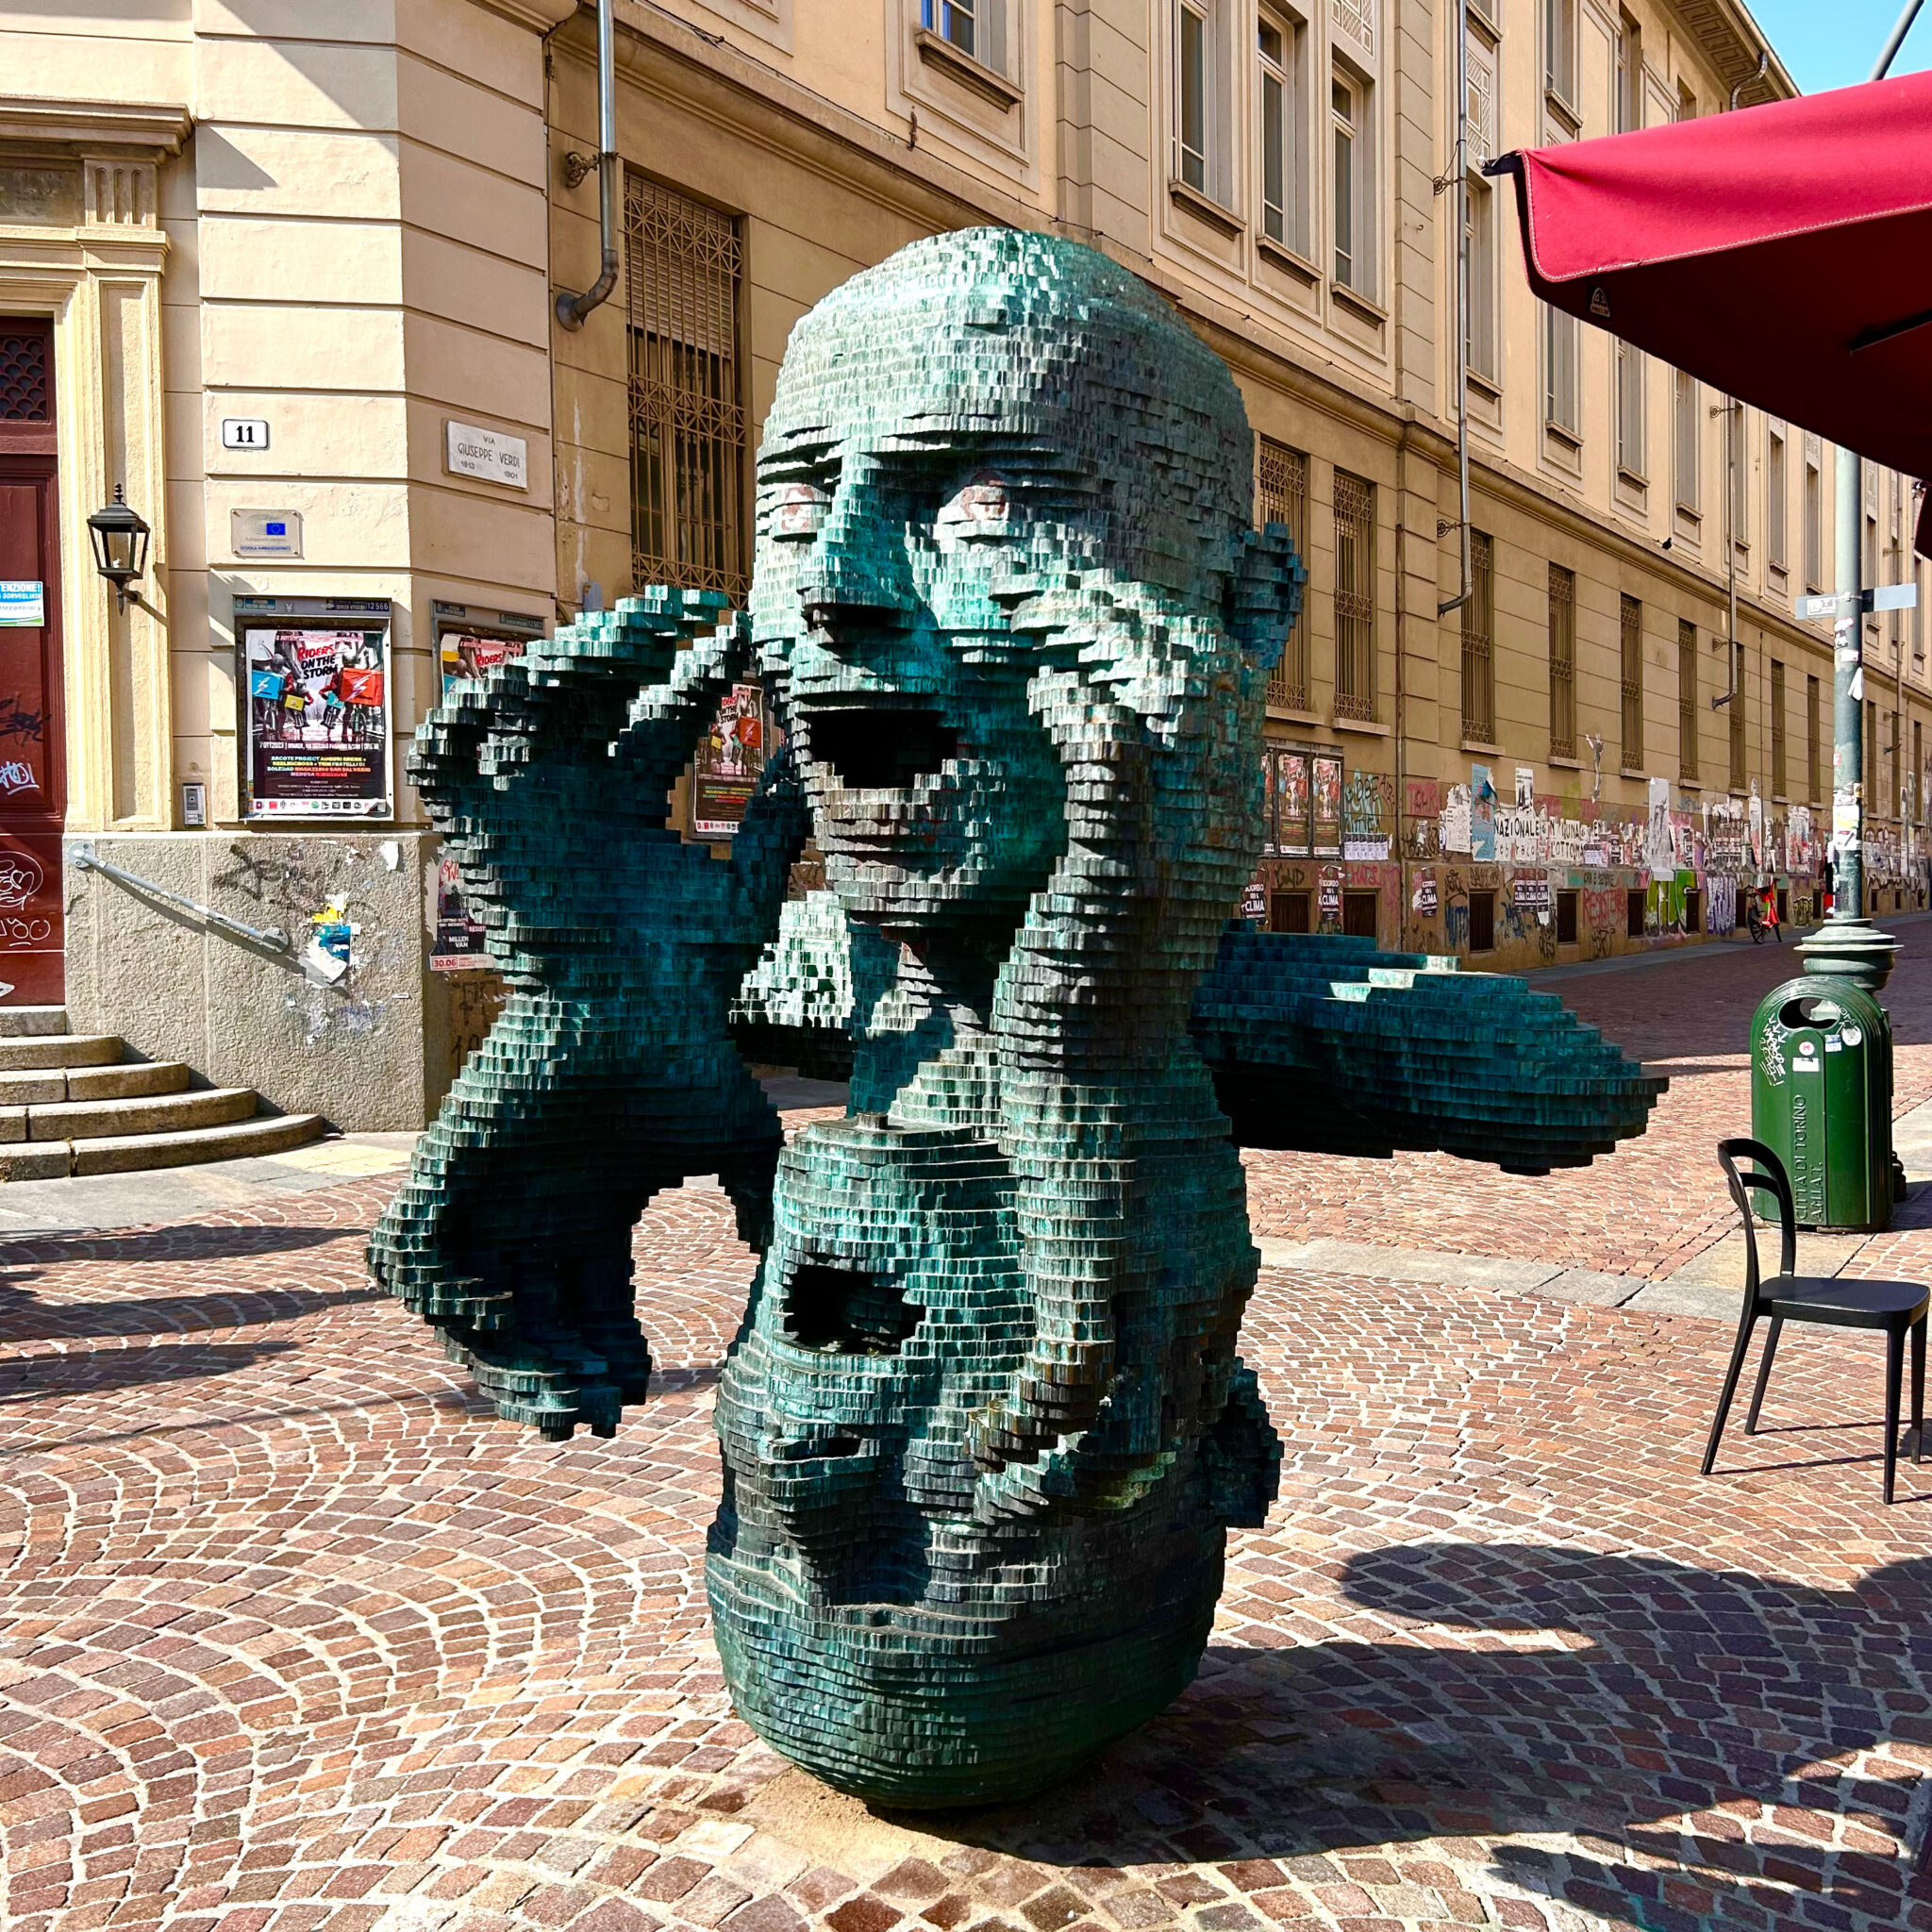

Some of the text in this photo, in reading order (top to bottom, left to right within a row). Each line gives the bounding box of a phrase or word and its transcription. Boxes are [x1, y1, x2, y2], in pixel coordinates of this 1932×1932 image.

[236, 425, 255, 442] 11
[483, 436, 495, 444] VIA
[458, 442, 520, 468] GIUSEPPE VERDI
[460, 460, 475, 469] 1813
[504, 471, 518, 479] 1901
[0, 583, 42, 592] ENZIONE!
[297, 644, 336, 661] RIDERS
[301, 655, 336, 670] ON THE
[476, 654, 503, 667] RIDERS
[304, 664, 339, 679] STORM
[1495, 818, 1540, 838] NAZIONALE
[1323, 894, 1339, 906] CLIMA
[1423, 894, 1437, 904] CLIMA
[1245, 900, 1265, 912] CLIMA
[434, 958, 457, 967] 30.06
[1792, 1094, 1807, 1150] TORINO
[1794, 1156, 1807, 1172] DI
